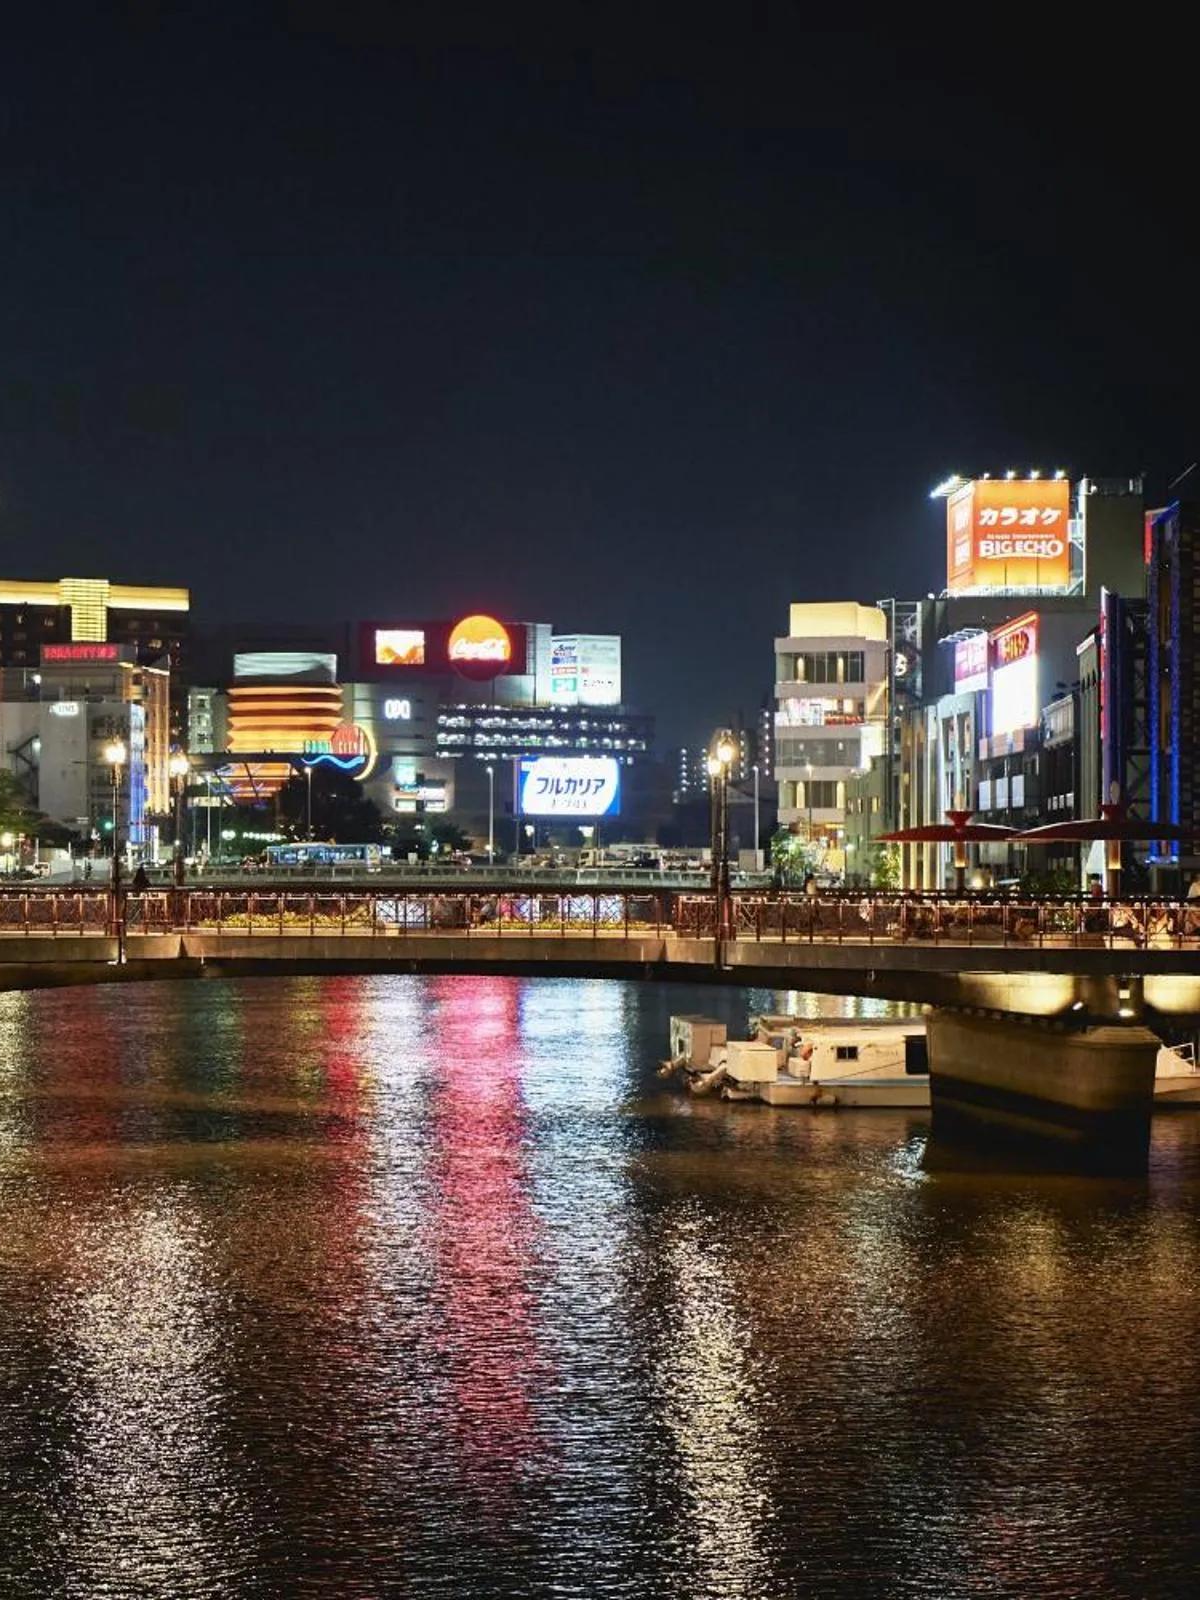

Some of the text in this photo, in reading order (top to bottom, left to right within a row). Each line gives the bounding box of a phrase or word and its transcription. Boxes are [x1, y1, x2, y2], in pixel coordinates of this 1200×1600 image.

[979, 507, 1062, 525] カラオケ
[980, 540, 1013, 558] BIG
[1015, 540, 1064, 558] ECHO
[536, 777, 605, 795] フルカリア
